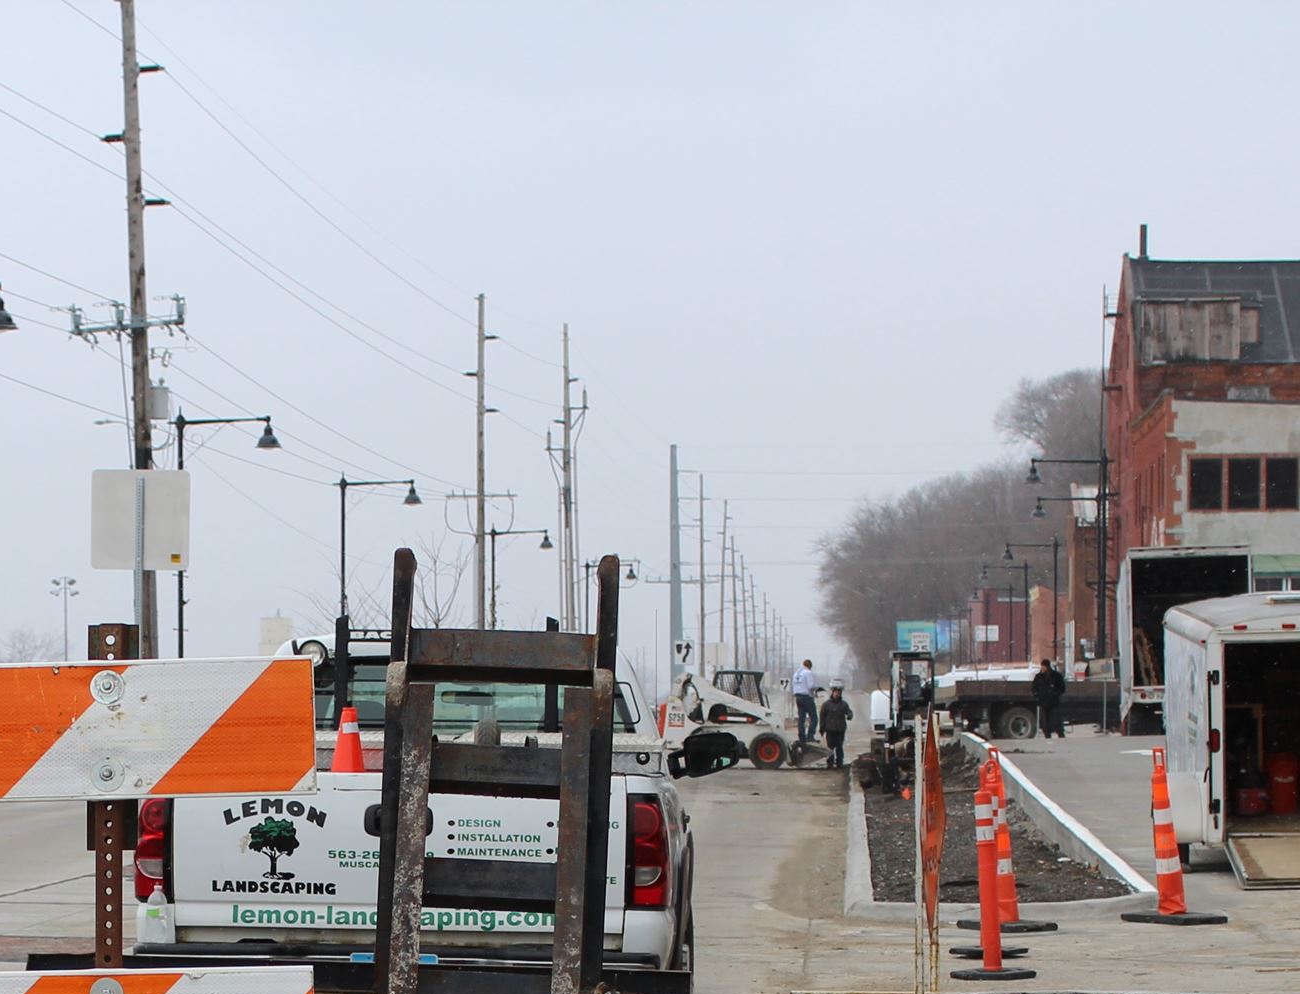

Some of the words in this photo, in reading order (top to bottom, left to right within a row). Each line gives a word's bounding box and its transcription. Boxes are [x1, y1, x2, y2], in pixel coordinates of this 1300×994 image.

[223, 799, 327, 828] LEMON
[458, 819, 500, 828] DESIGN
[458, 834, 540, 843] INSTALLATION
[457, 848, 541, 857] MAINTENANCE
[212, 880, 336, 895] LANDSCAPING
